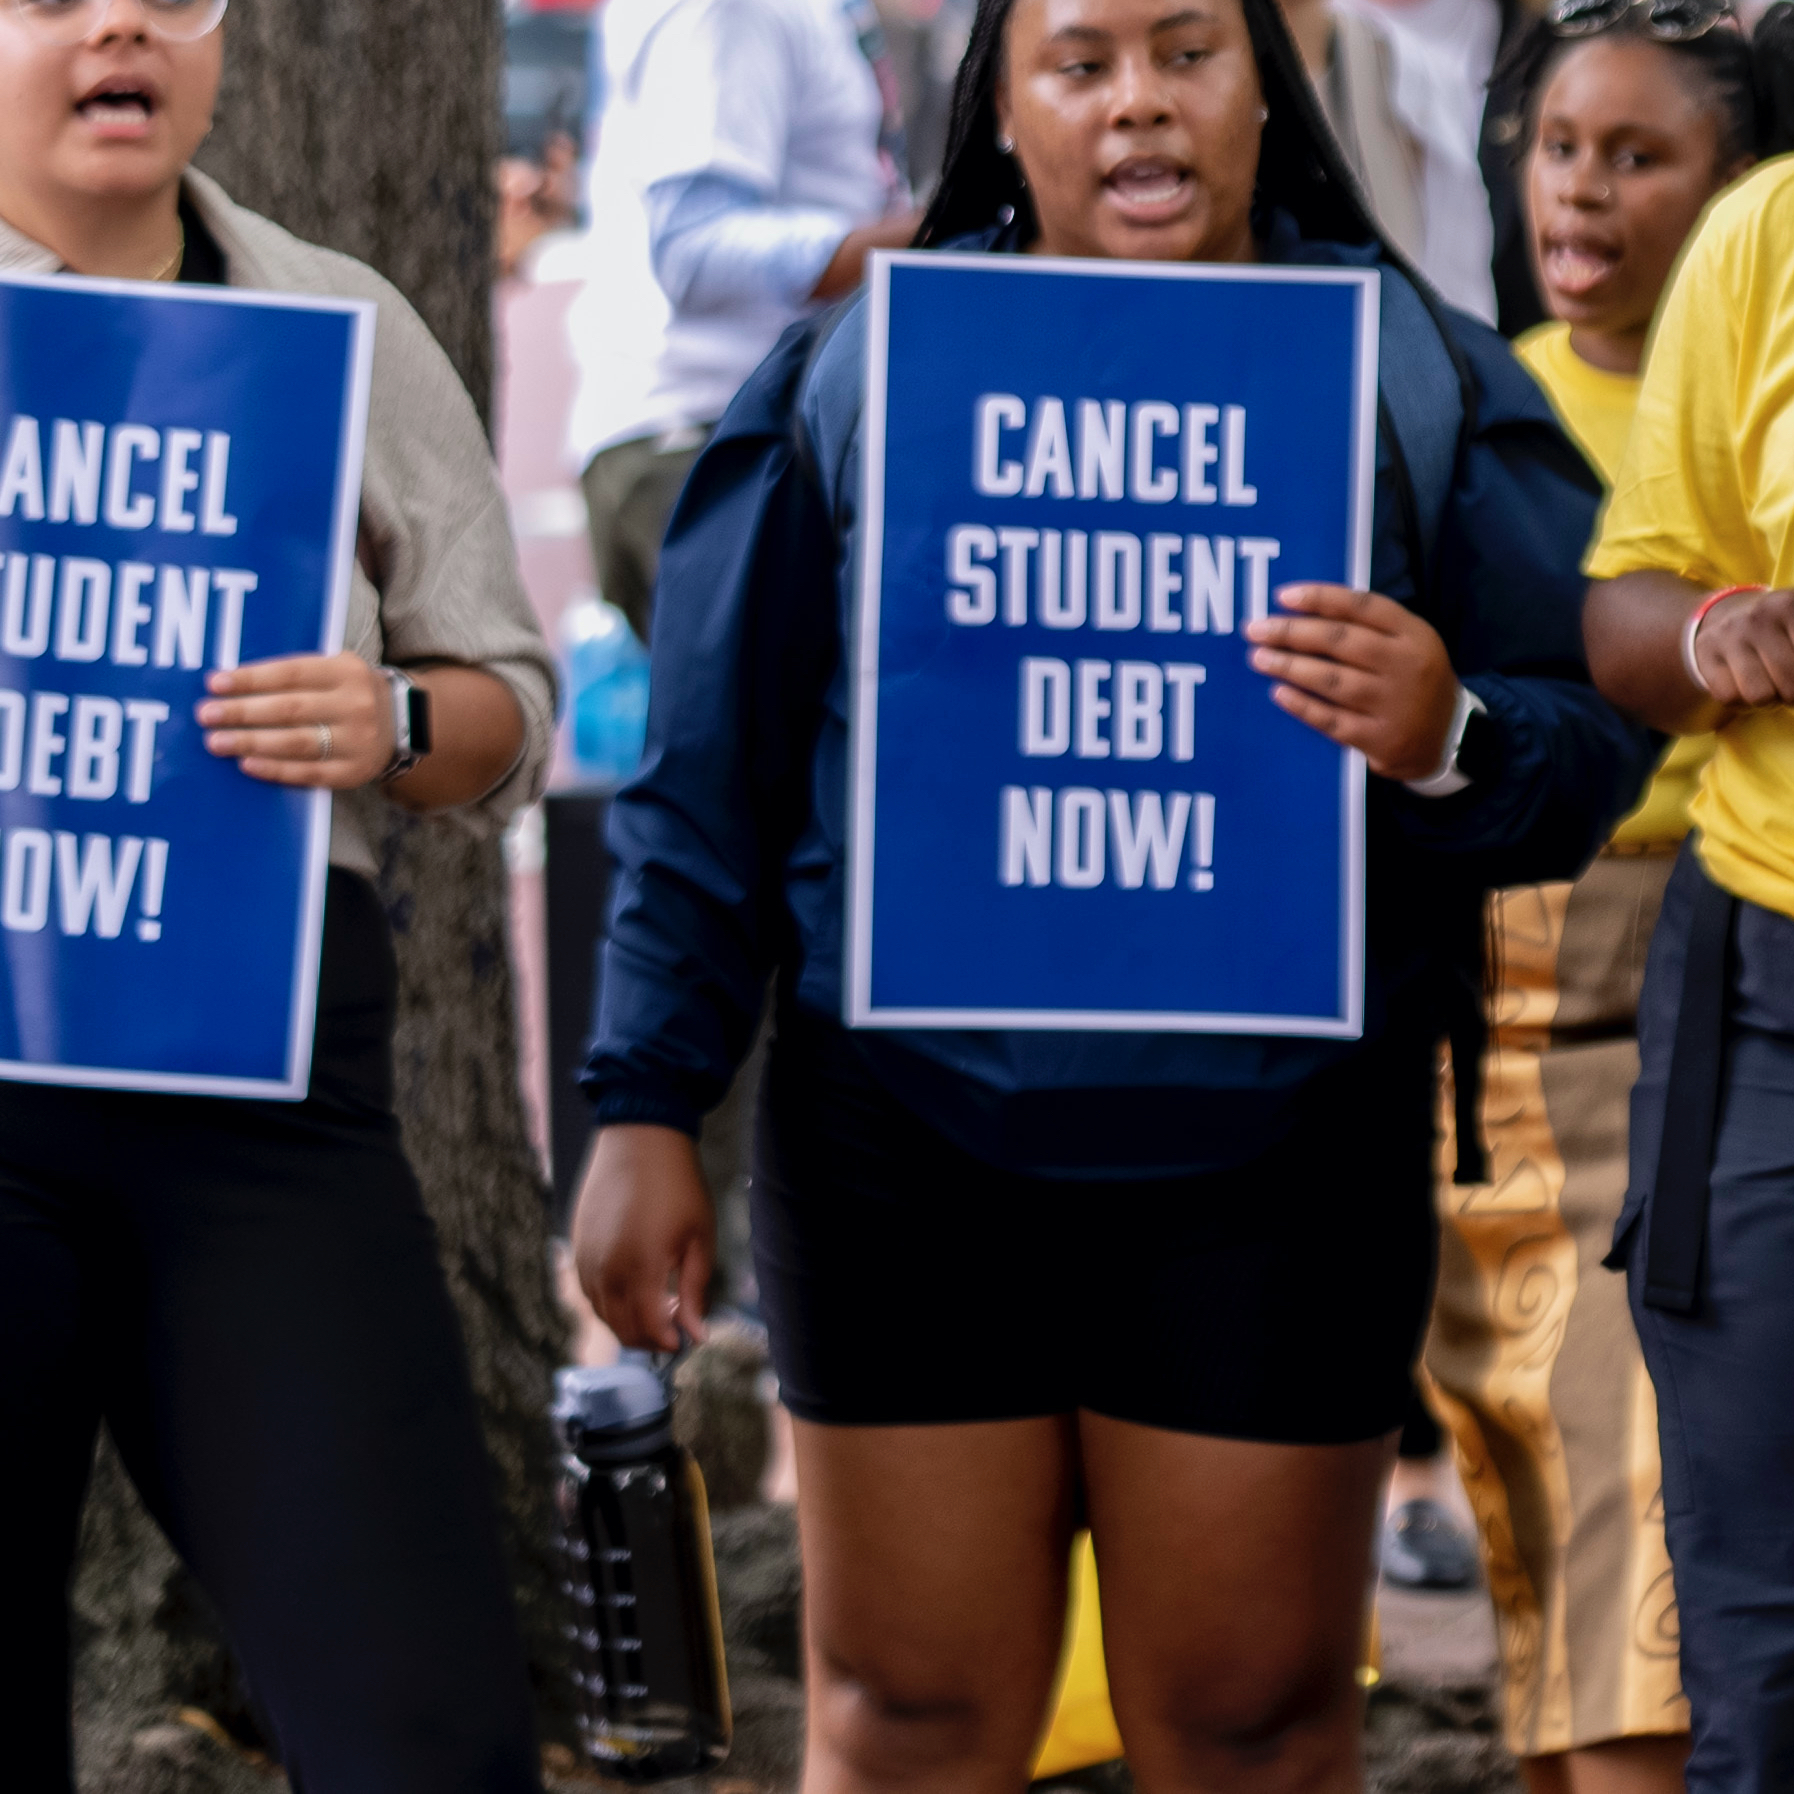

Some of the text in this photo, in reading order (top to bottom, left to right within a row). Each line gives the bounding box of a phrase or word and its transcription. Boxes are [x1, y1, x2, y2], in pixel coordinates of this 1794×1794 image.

[0, 415, 239, 536] ANCEL
[973, 393, 1258, 507] CANCEL
[0, 552, 259, 671] UDENT
[946, 525, 1280, 635] STUDENT
[1018, 656, 1206, 763] DEBT
[0, 827, 170, 943] OW!
[1000, 784, 1216, 892] NOW!
